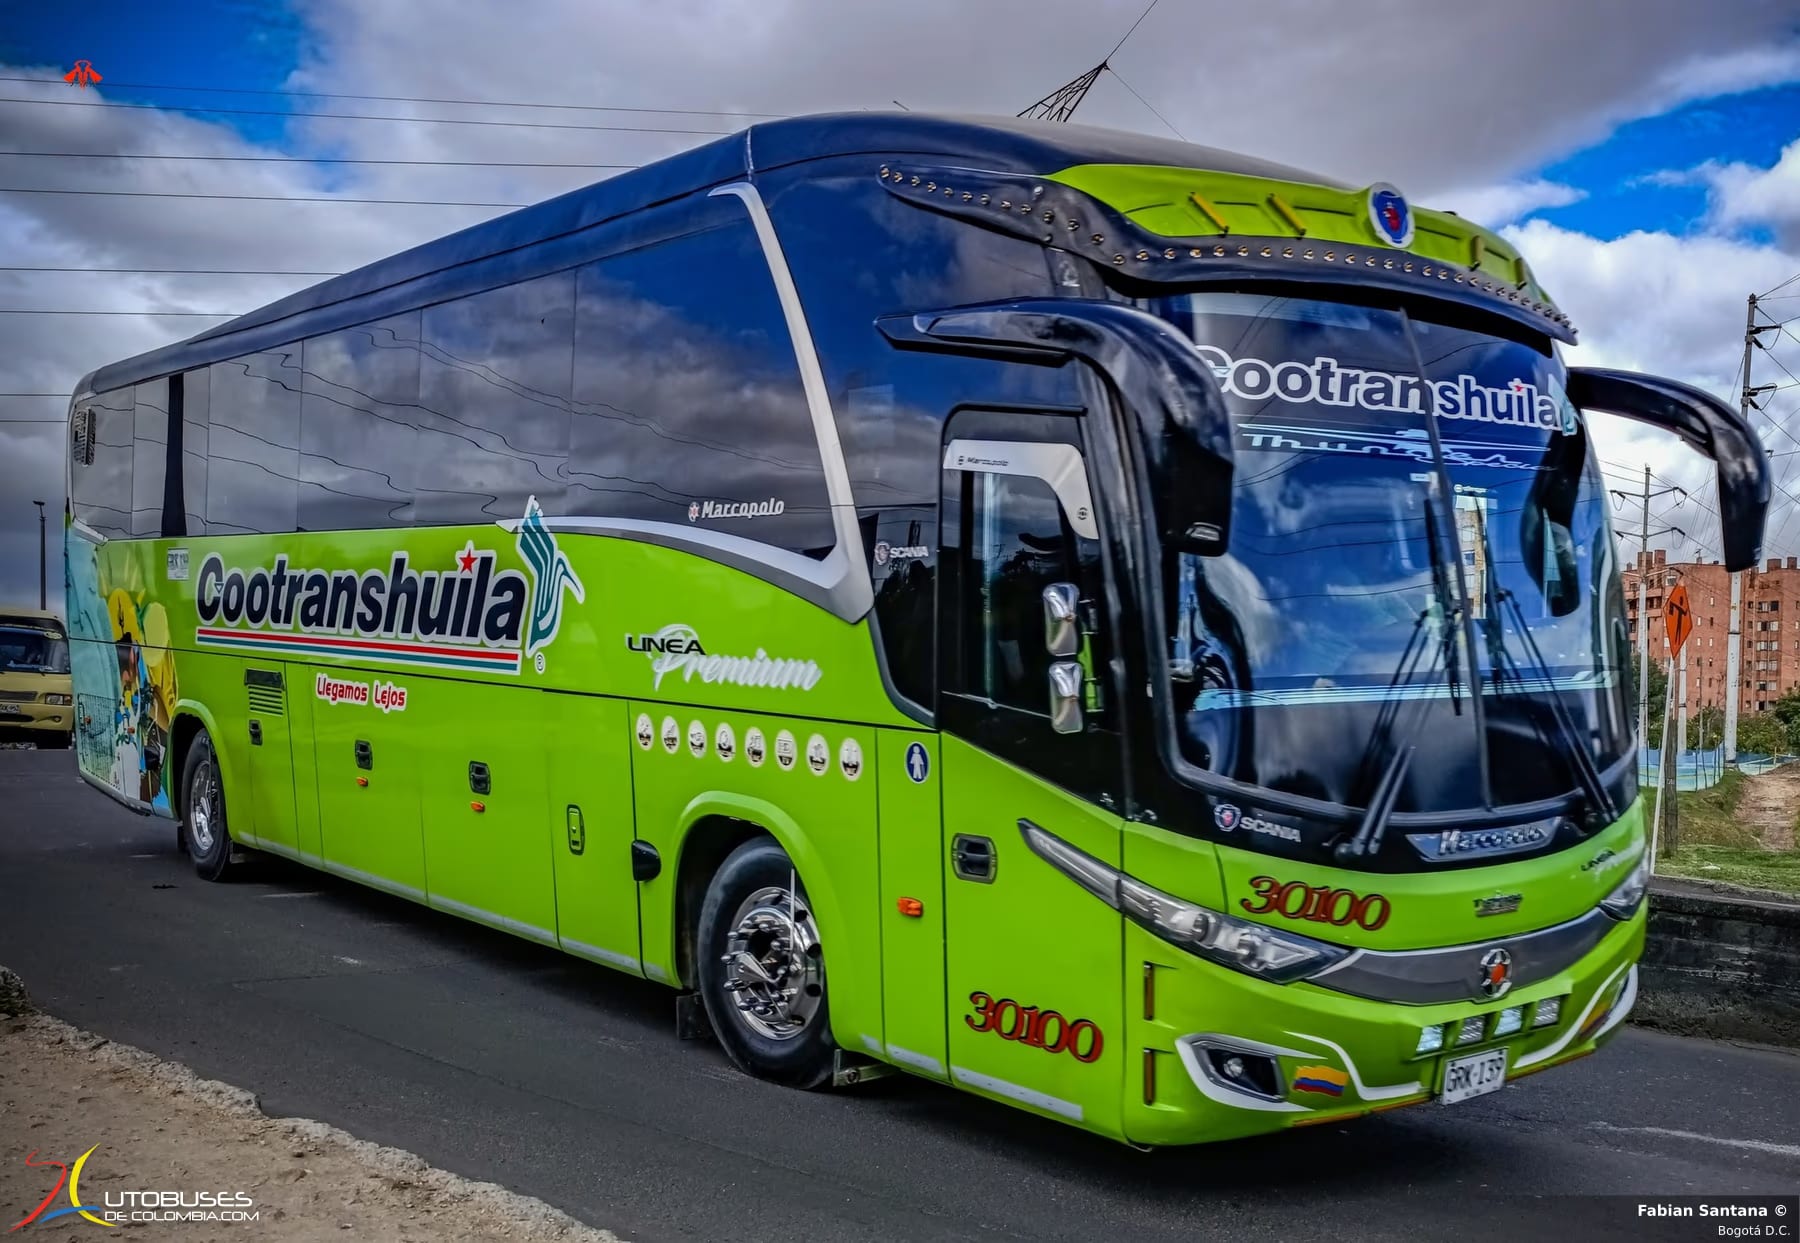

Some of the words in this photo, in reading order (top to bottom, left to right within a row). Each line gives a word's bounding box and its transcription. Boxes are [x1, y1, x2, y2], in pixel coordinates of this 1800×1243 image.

[702, 498, 784, 519] Marcopolo
[890, 546, 929, 558] SCANIA
[197, 549, 531, 642] Cootranshuila
[652, 625, 823, 692] Premium
[317, 677, 367, 702] Llegamos
[374, 684, 406, 709] Lejos
[1240, 817, 1301, 842] SCANIA
[1240, 875, 1391, 931] 30100
[964, 991, 1104, 1063] 30100
